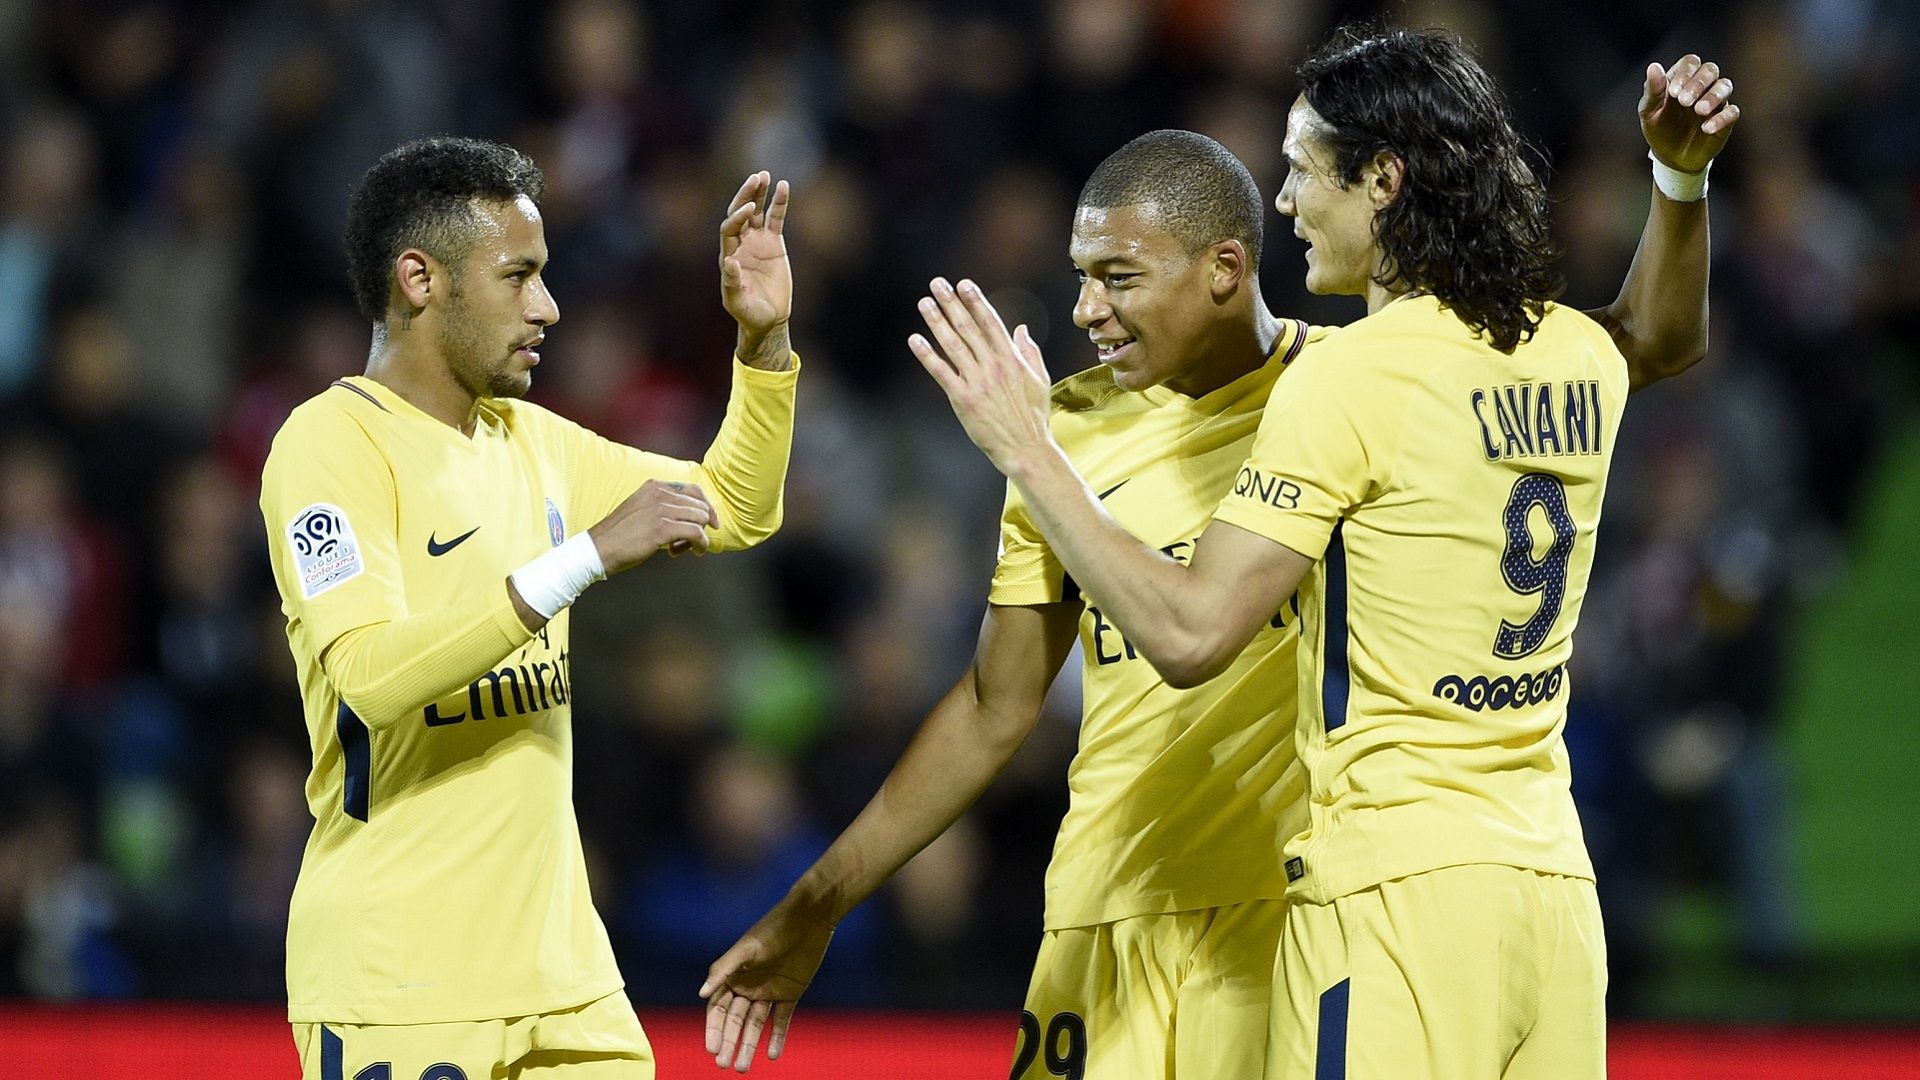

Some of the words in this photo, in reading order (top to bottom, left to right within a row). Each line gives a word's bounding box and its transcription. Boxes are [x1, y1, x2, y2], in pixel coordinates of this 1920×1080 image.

[1470, 380, 1602, 461] CAVANI
[1235, 467, 1302, 509] QNB
[305, 555, 355, 583] Conforama
[307, 552, 338, 573] LIGUE
[1492, 472, 1577, 660] 9
